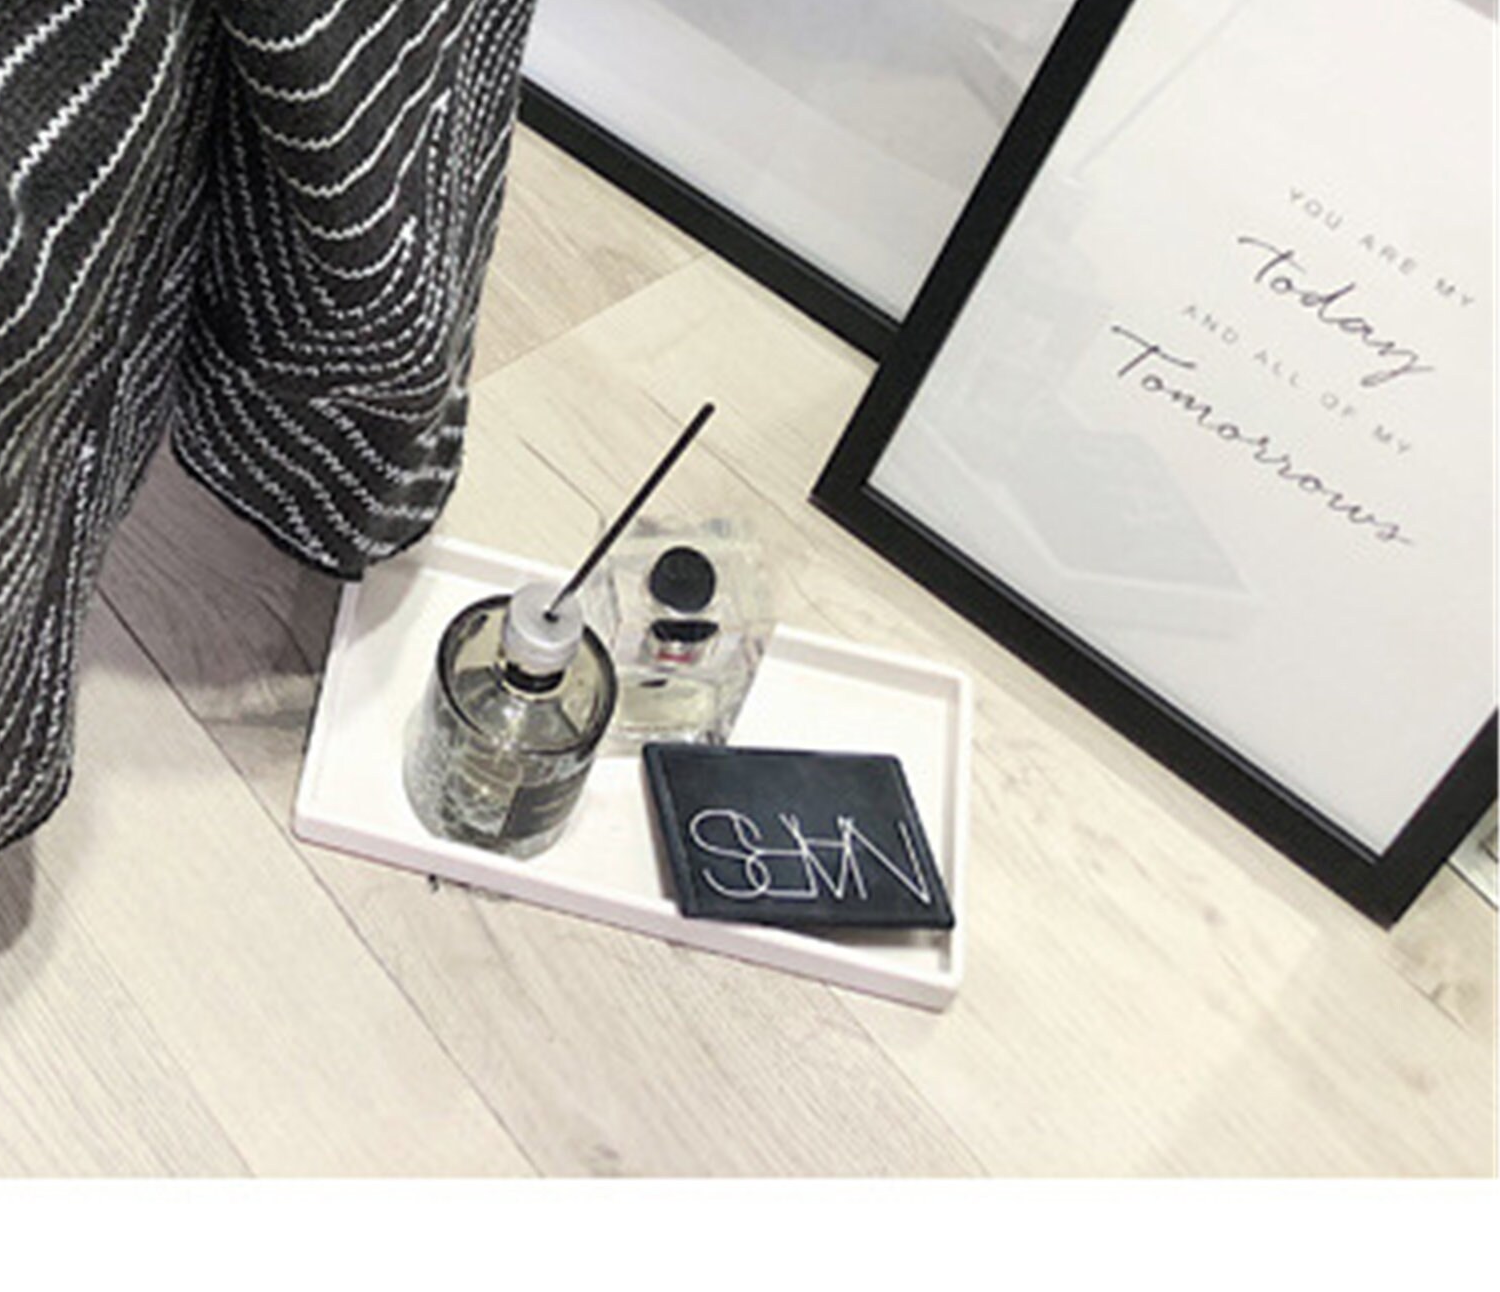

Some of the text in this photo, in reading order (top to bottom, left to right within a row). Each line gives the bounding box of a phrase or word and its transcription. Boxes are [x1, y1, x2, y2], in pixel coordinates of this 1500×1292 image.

[1289, 187, 1475, 307] YOU ARE MY
[1111, 325, 1414, 545] Tomorrows
[1183, 305, 1411, 454] AND ALL OF MY
[689, 809, 931, 903] NARS
